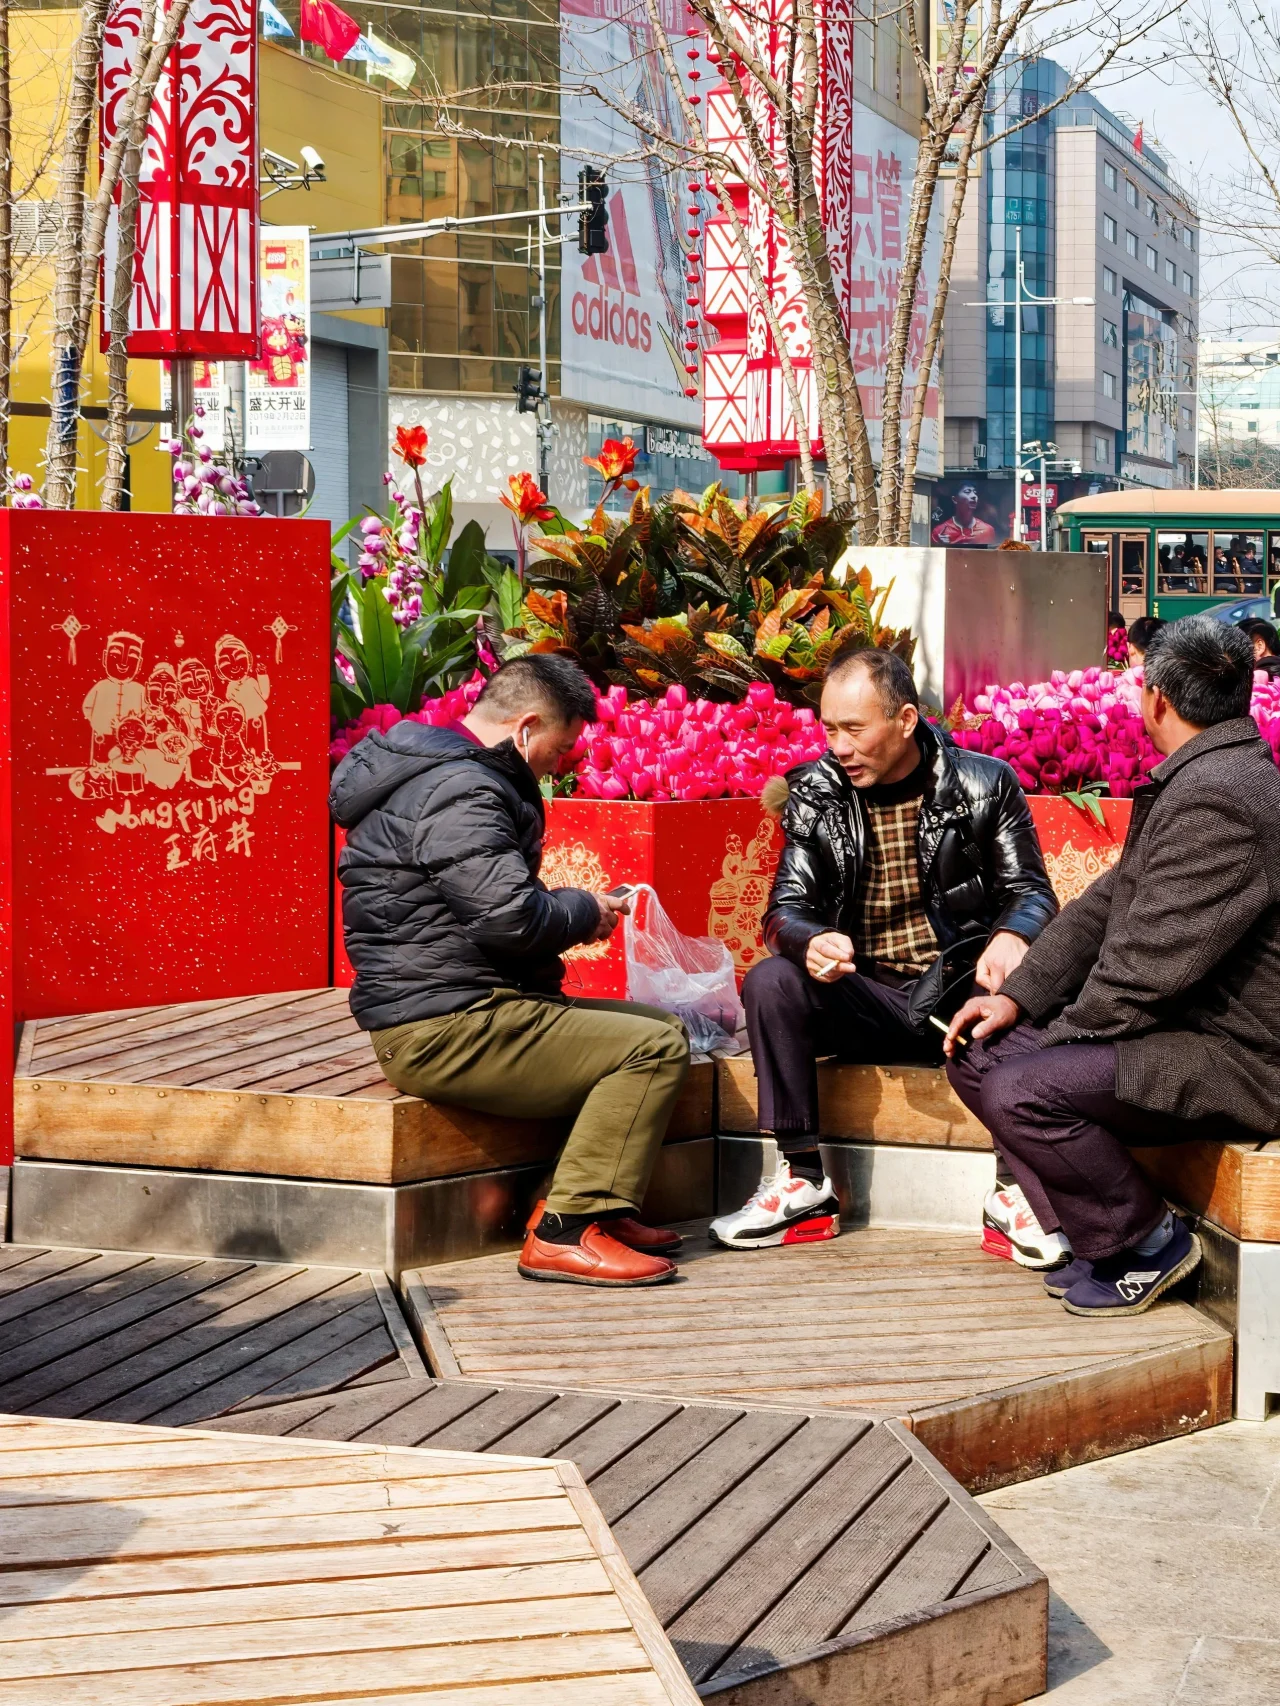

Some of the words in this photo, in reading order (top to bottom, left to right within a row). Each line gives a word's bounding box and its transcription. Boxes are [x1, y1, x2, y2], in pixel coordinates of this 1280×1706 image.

[571, 285, 652, 353] adidas
[249, 396, 306, 411] 盛大开业
[163, 817, 255, 871] 王府井
